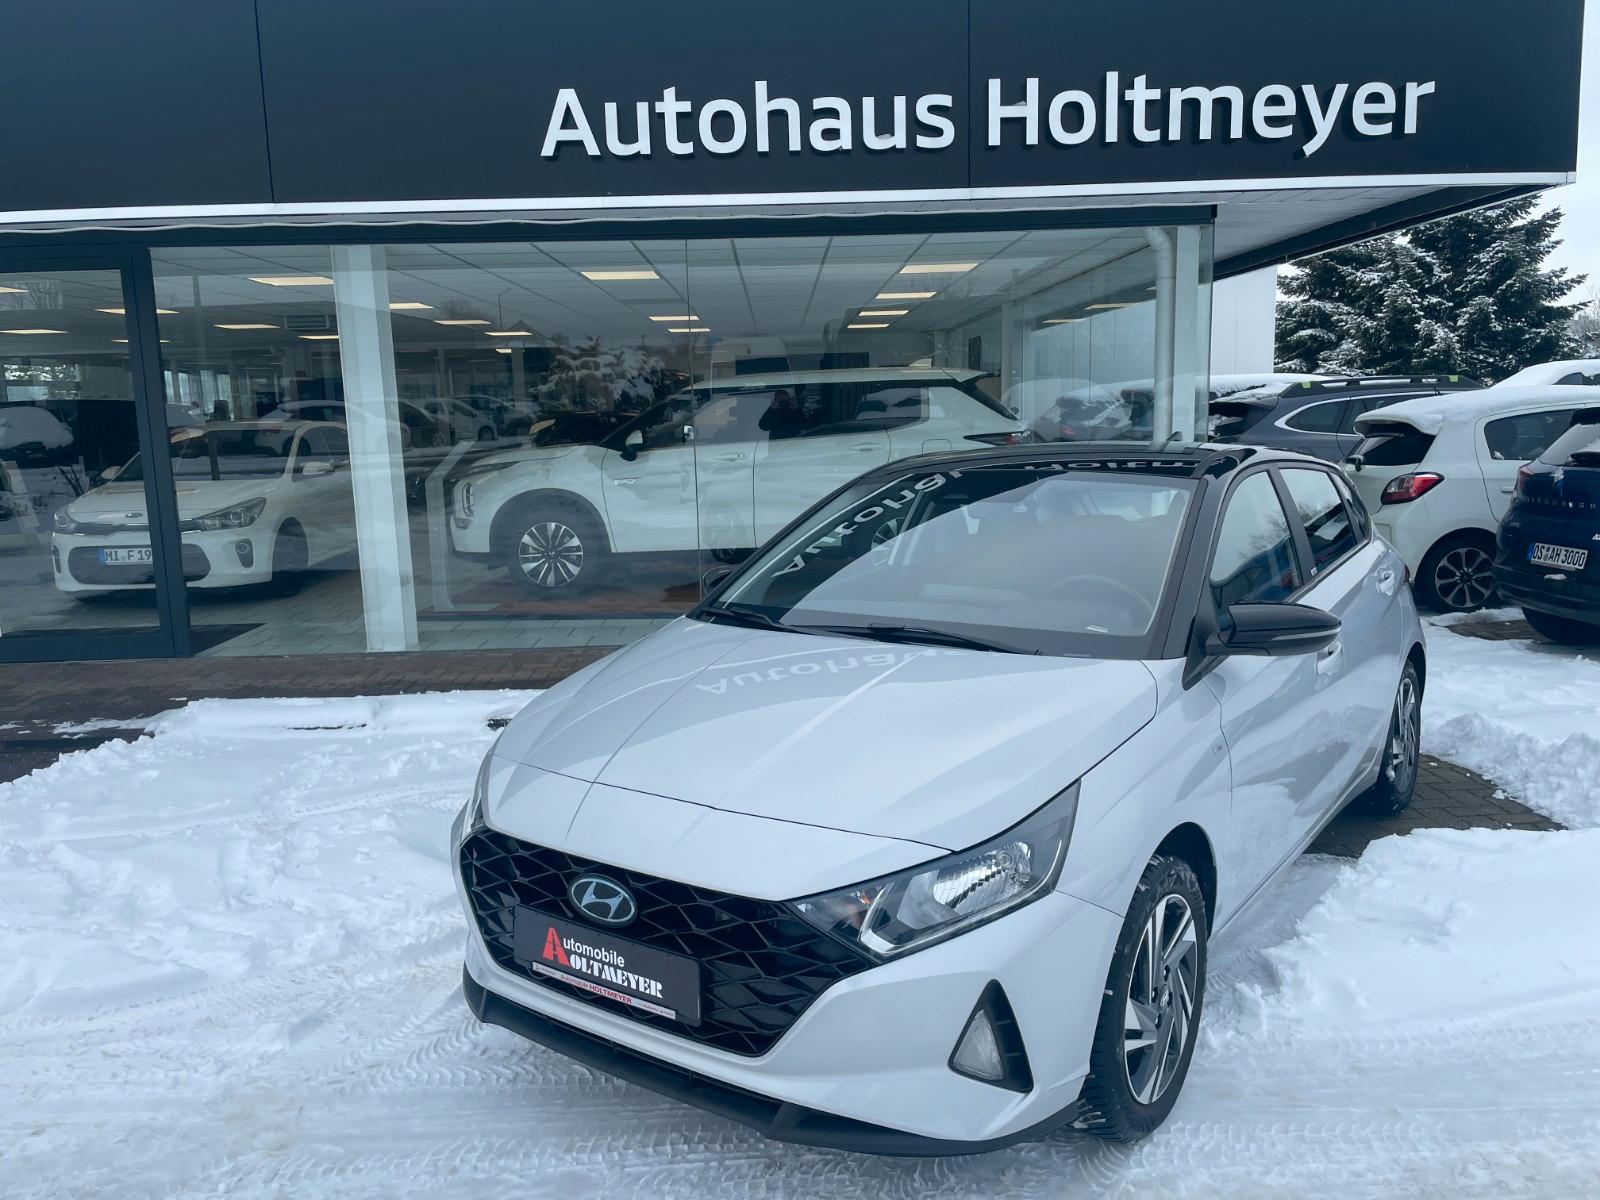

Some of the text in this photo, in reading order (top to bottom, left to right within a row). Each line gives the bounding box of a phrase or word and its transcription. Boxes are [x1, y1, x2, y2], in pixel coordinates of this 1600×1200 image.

[540, 70, 1437, 158] Autohaus Holtmeyer
[104, 550, 120, 561] MI
[1549, 547, 1561, 563] AH
[1562, 549, 1586, 567] 3000
[542, 926, 625, 967] Automobile
[589, 984, 633, 1005] HOLTMEYER
